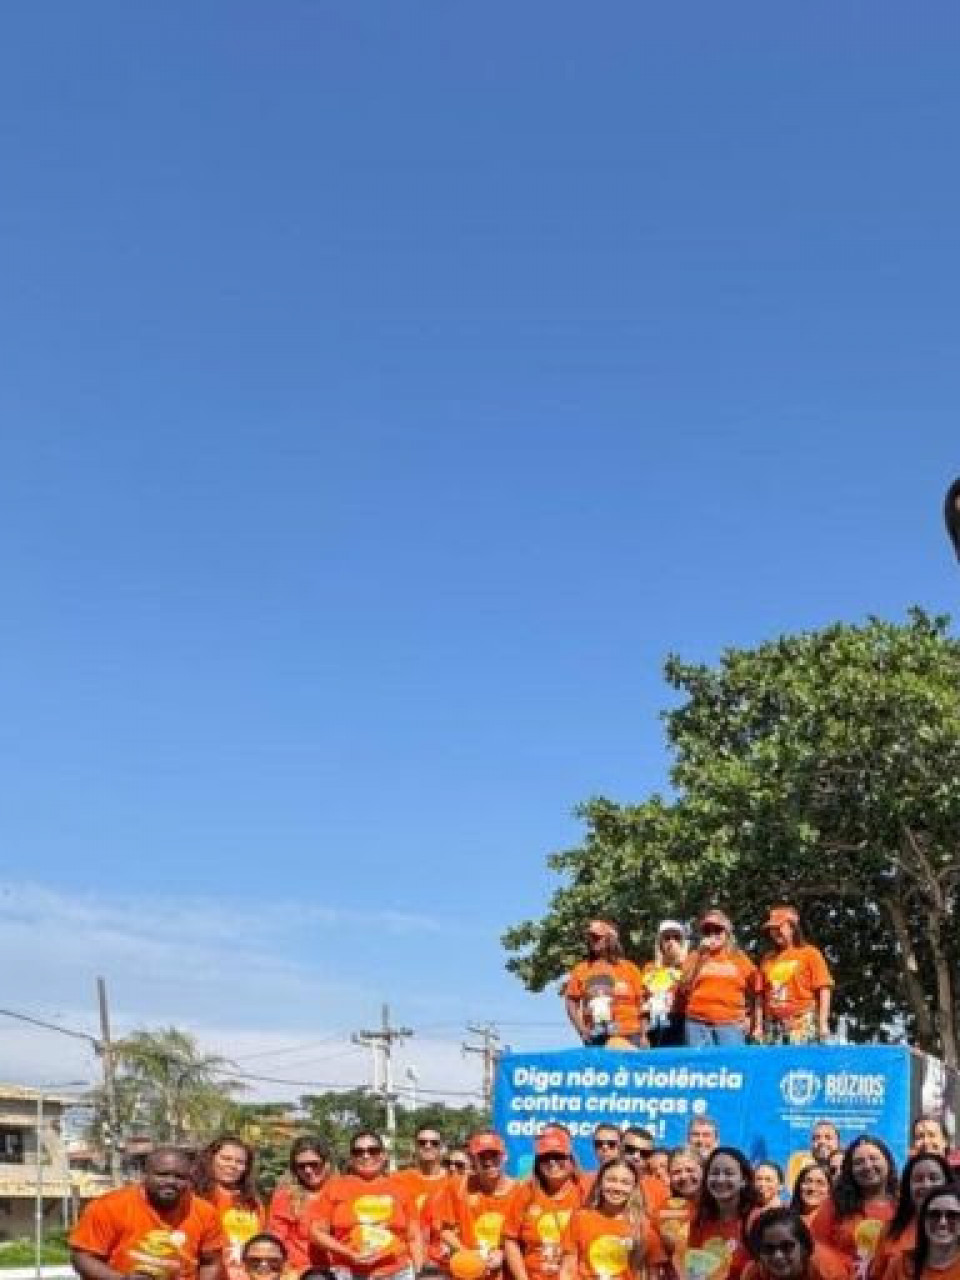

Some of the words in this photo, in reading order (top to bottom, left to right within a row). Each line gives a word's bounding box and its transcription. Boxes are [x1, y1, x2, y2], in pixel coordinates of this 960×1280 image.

[513, 1067, 562, 1092] Diga
[567, 1066, 610, 1086] não
[634, 1066, 744, 1089] violência
[511, 1093, 581, 1111] contra
[584, 1092, 689, 1119] crianças
[692, 1098, 708, 1115] e
